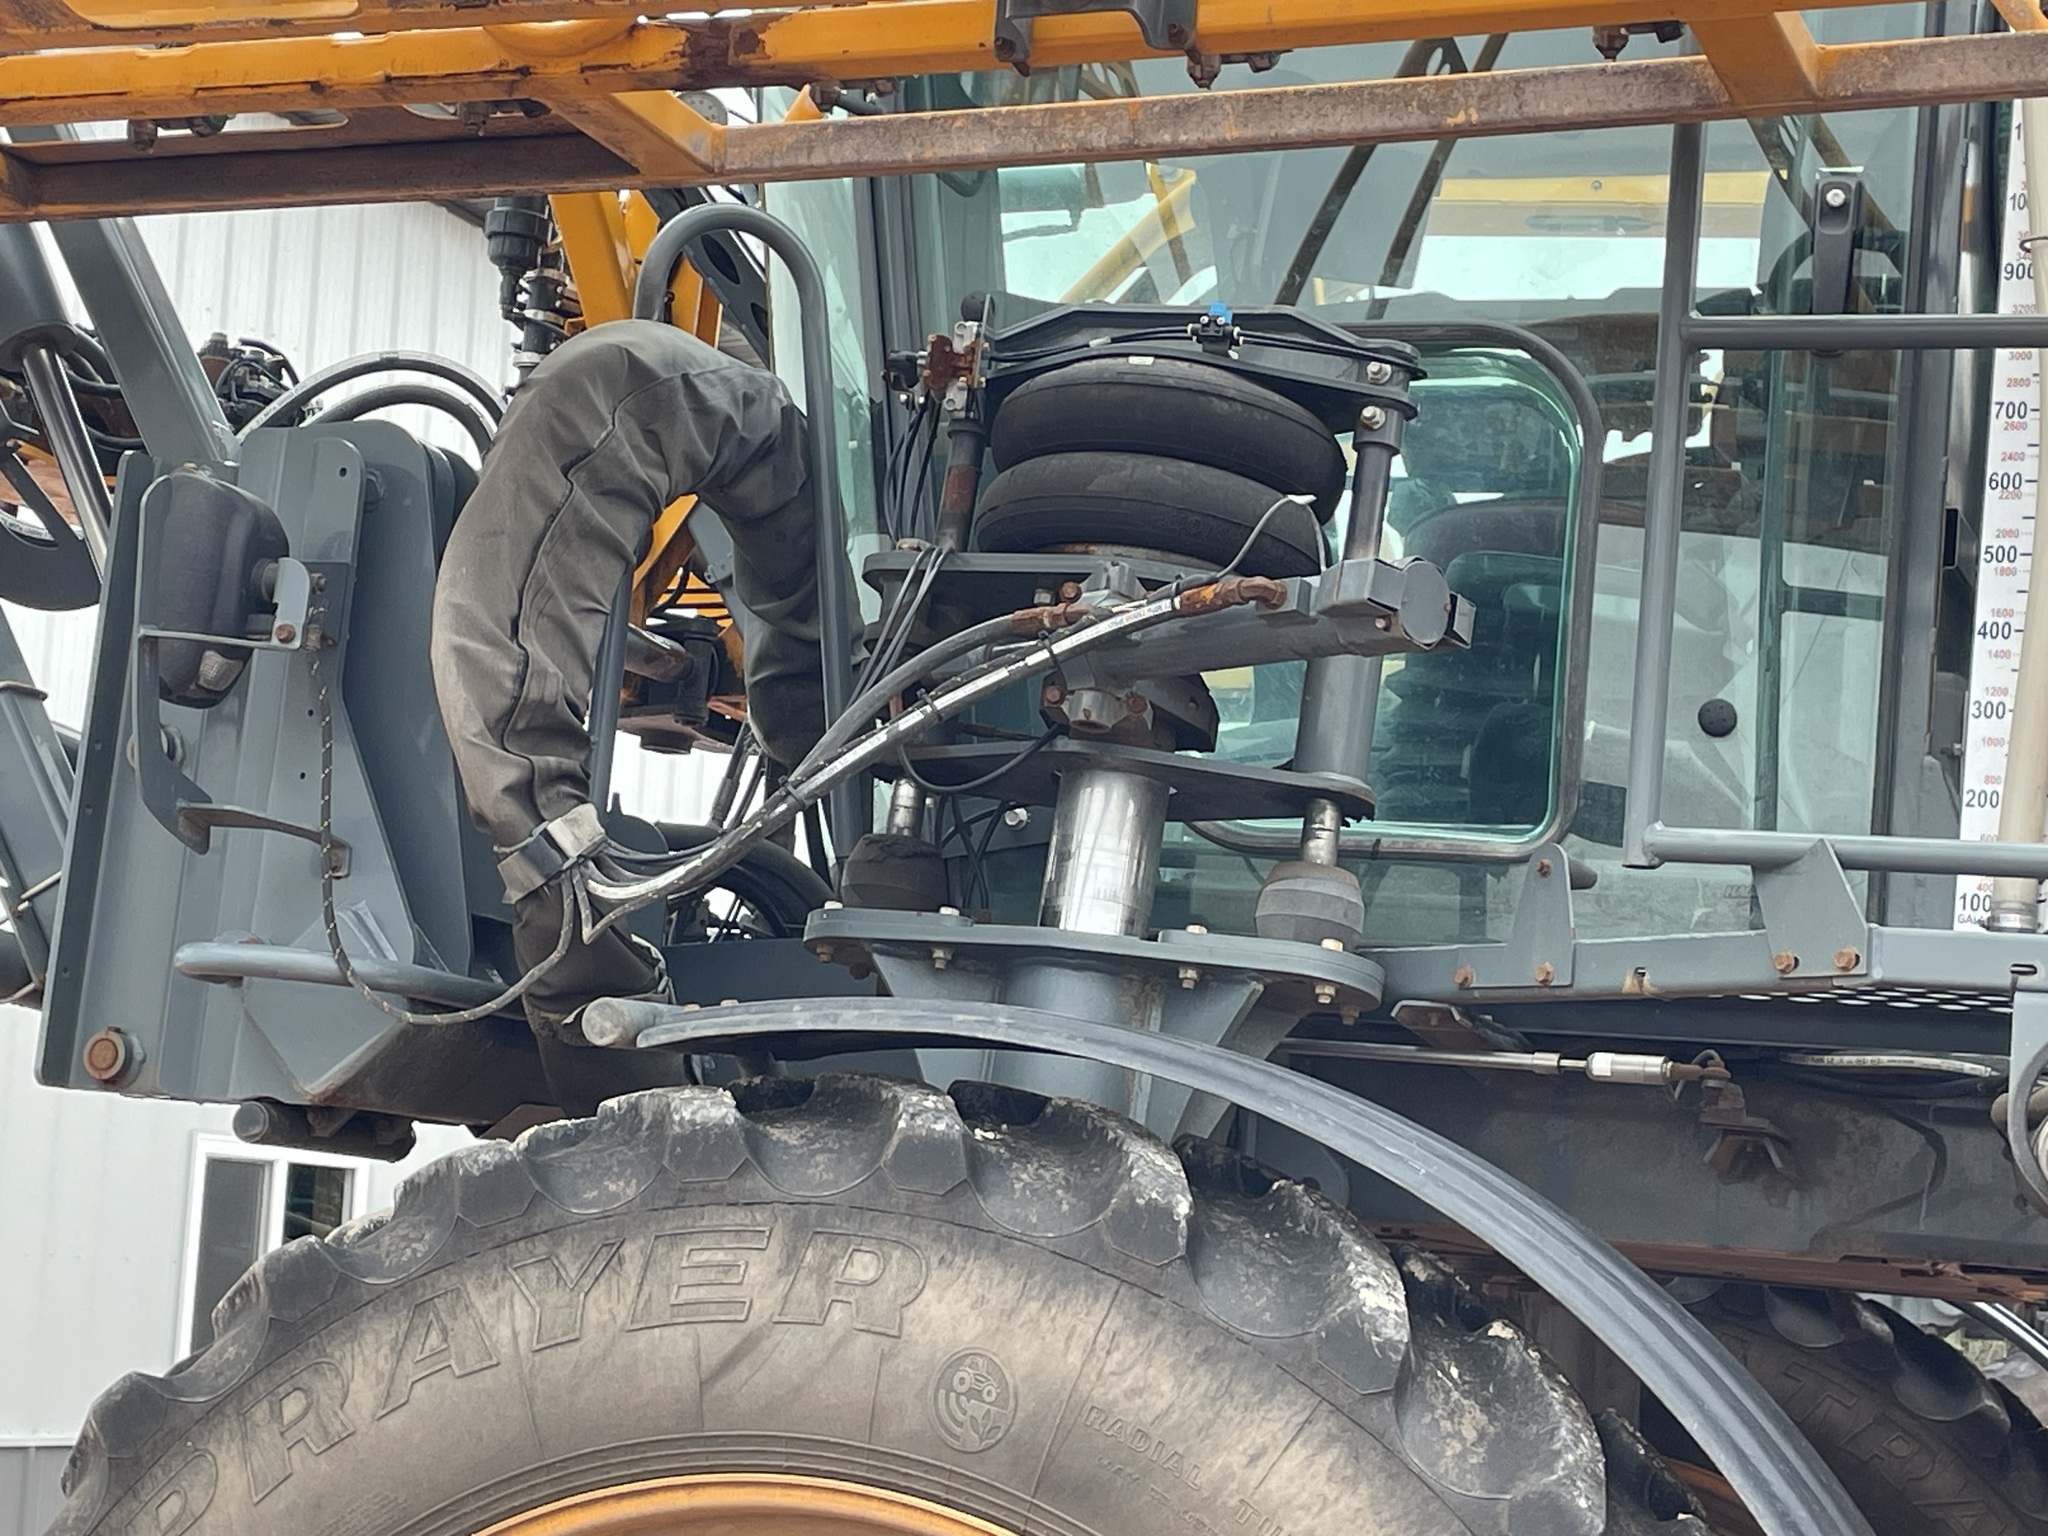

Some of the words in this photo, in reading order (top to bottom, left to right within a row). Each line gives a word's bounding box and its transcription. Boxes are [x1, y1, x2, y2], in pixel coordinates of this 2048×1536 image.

[2008, 351, 2033, 361] 3000
[2006, 378, 2031, 388] 2800
[1995, 401, 2028, 420] 700
[2003, 421, 2028, 431] 2600
[2001, 452, 2025, 462] 2400
[1989, 472, 2022, 490] 600
[1998, 490, 2022, 500] 2200
[1995, 528, 2020, 539] 2000
[1983, 545, 2018, 563] 500
[1993, 566, 2017, 577] 1800
[1991, 608, 2014, 618] 1600
[1977, 621, 2012, 640] 400
[1988, 649, 2011, 660] 1400
[1985, 686, 2009, 697] 1200
[1971, 700, 2006, 720] 300
[1981, 736, 2005, 748] 1000
[1965, 788, 2000, 809] 200
[1959, 892, 1992, 913] 100
[1081, 1404, 1202, 1493] RADIAL
